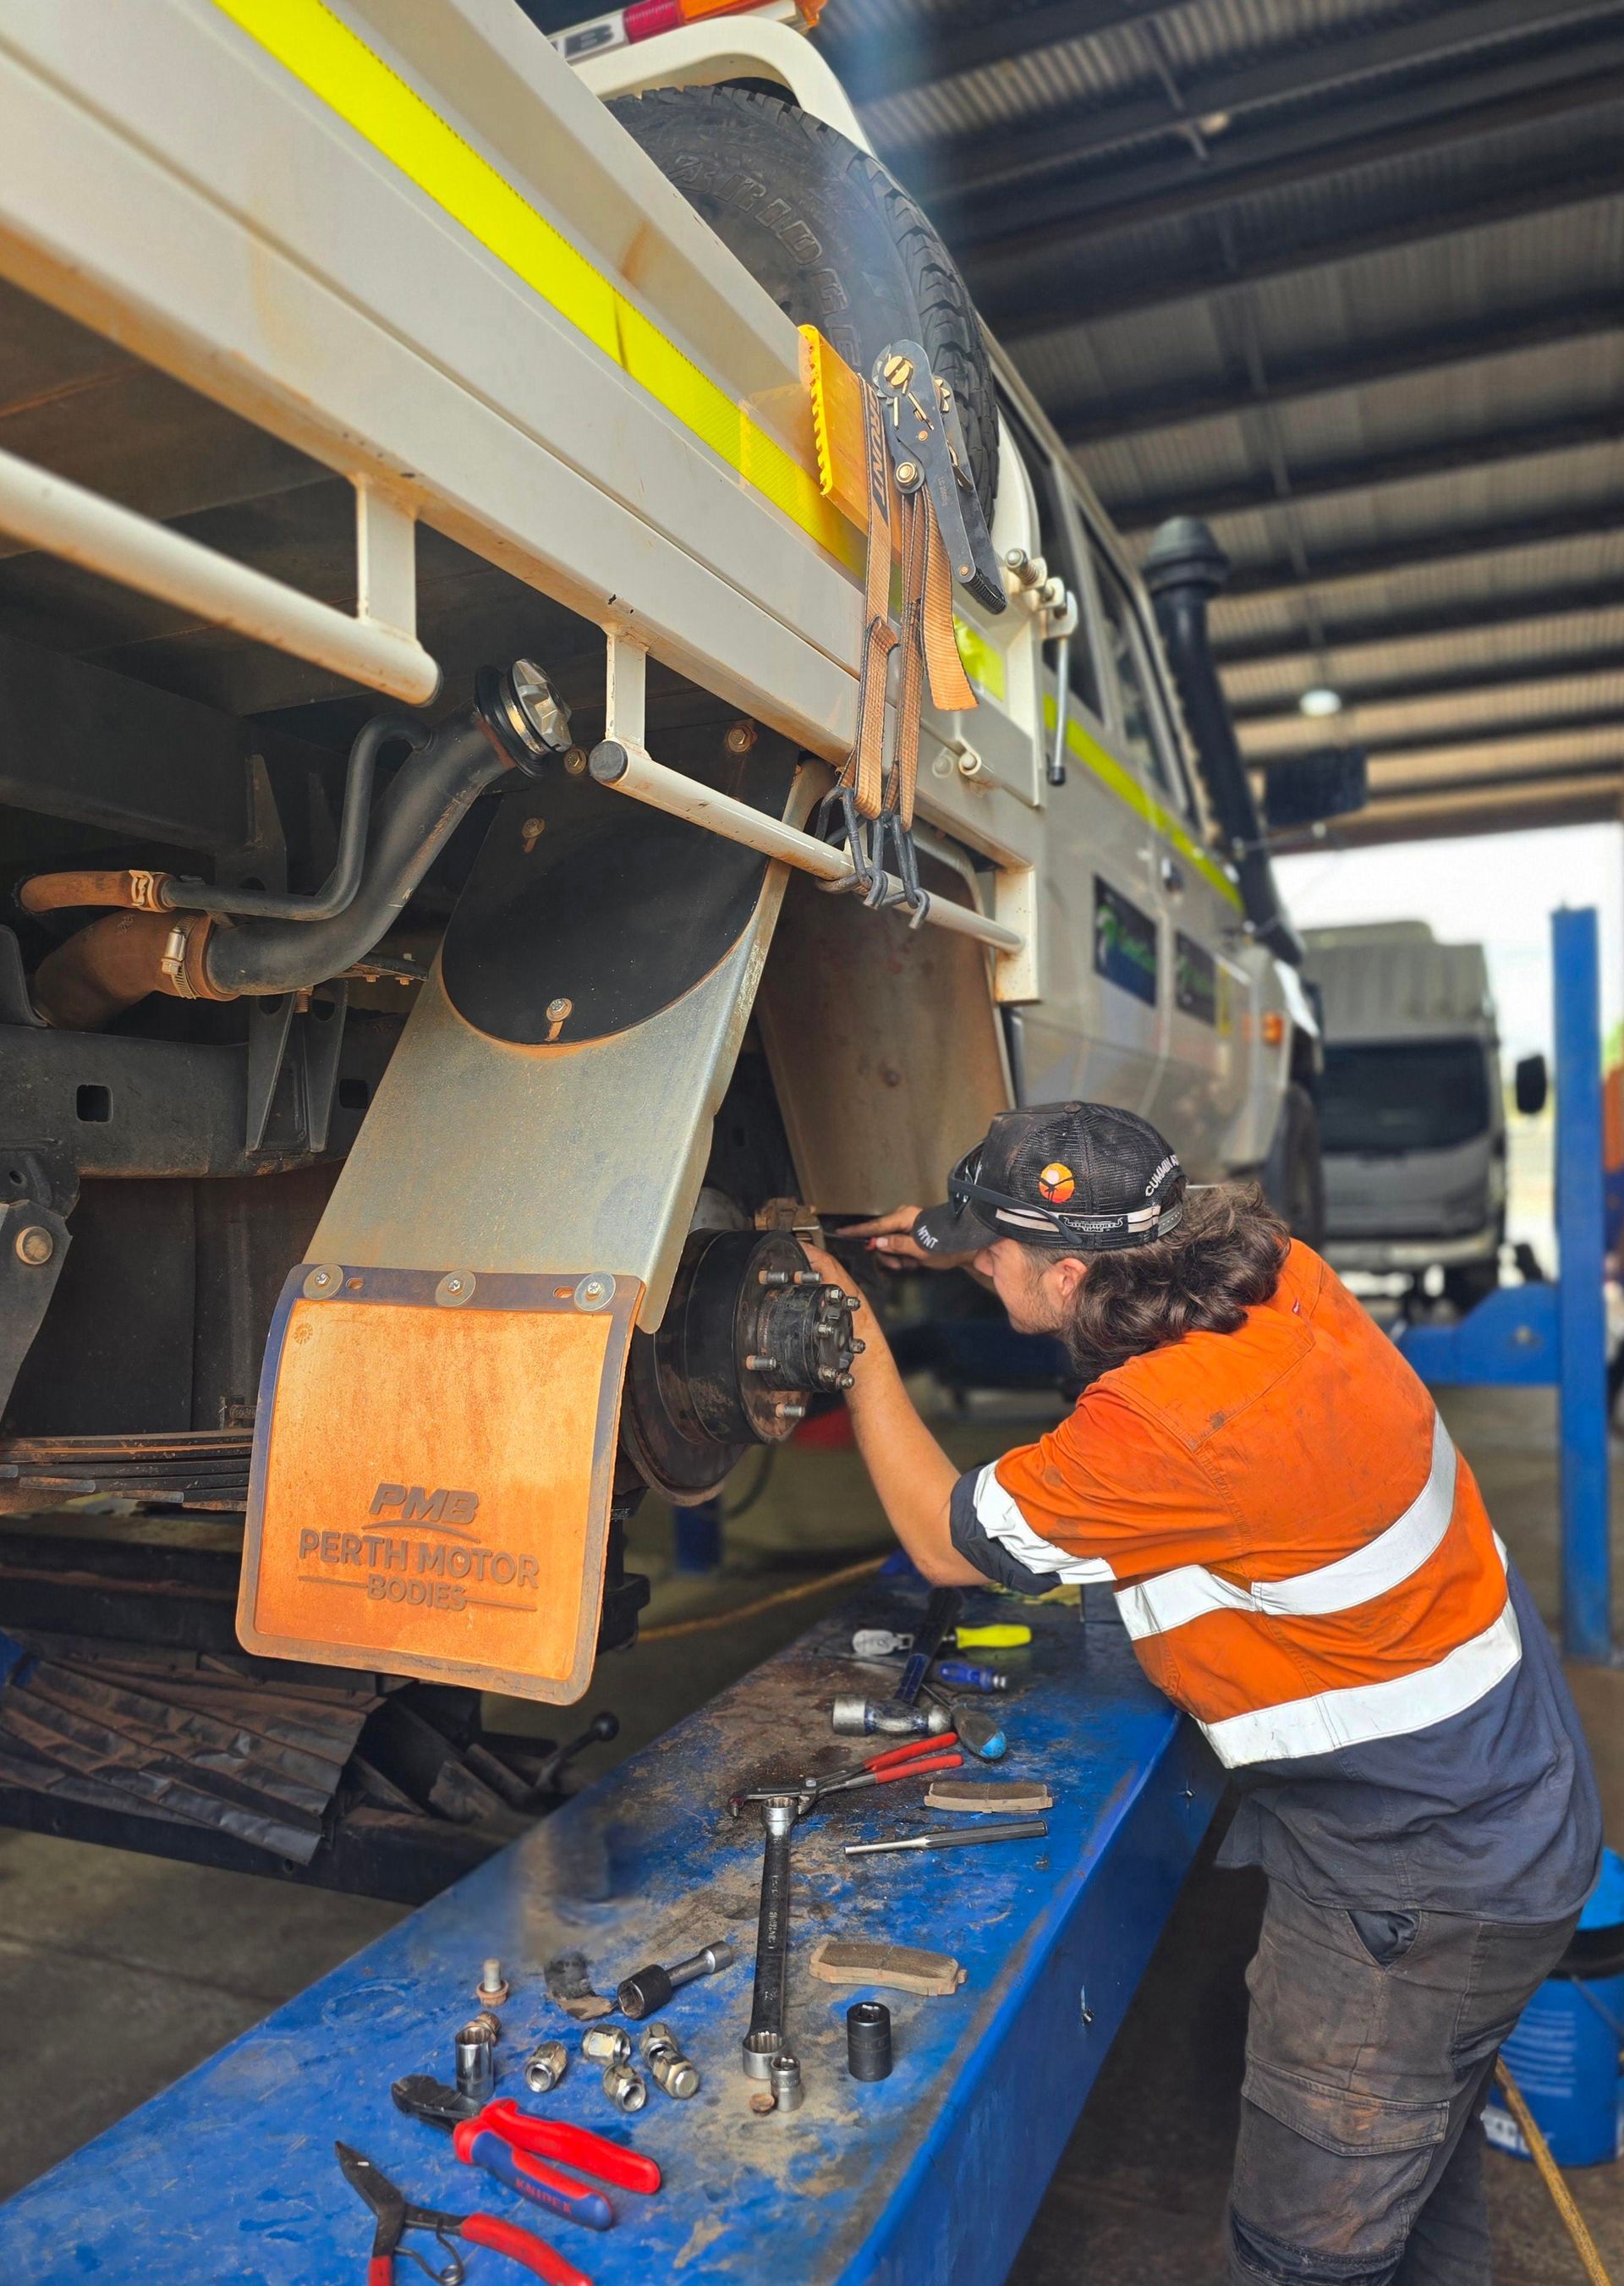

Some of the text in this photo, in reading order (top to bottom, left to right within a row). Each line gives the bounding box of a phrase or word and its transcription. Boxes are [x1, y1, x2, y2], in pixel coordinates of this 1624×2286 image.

[369, 1482, 480, 1524] PMB
[299, 1528, 540, 1589] PERTH MOTOR
[367, 1573, 467, 1612] BODIES
